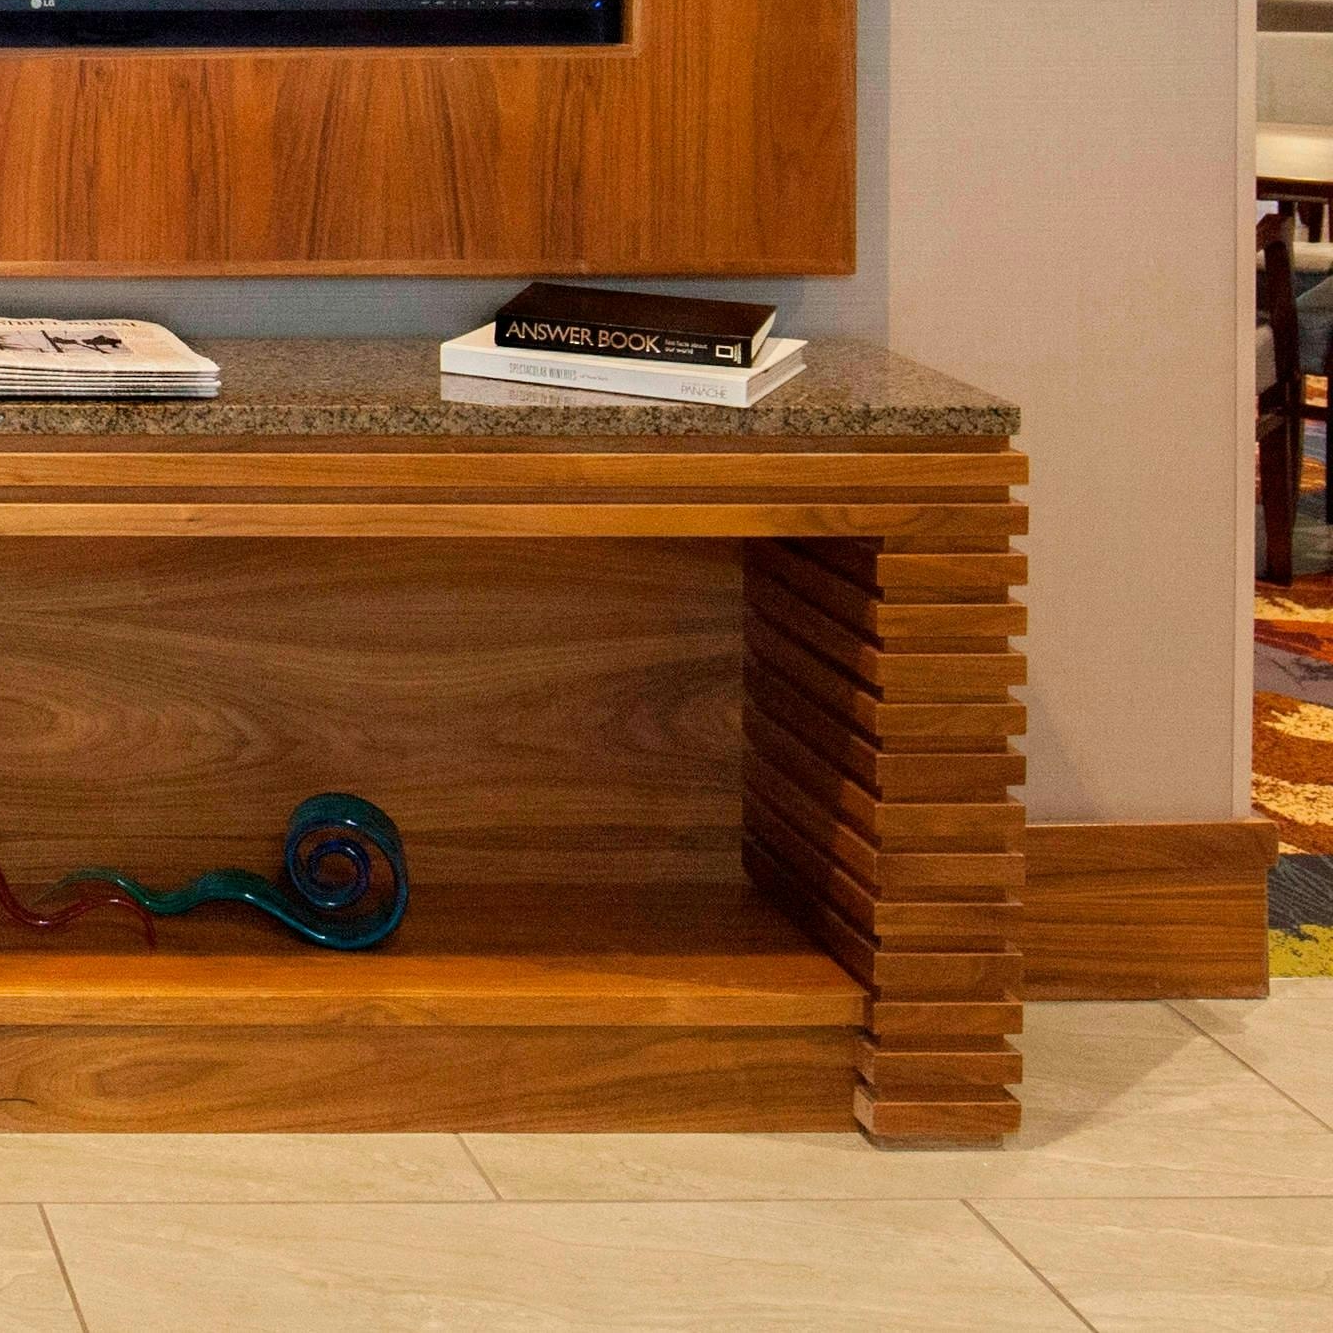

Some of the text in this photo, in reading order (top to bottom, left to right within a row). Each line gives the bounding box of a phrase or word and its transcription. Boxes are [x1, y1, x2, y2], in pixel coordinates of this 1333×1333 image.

[42, 0, 56, 8] LG
[505, 320, 661, 353] ANSWER BOOK
[508, 361, 548, 379] SPECTACULAR
[680, 384, 728, 400] PANACHE
